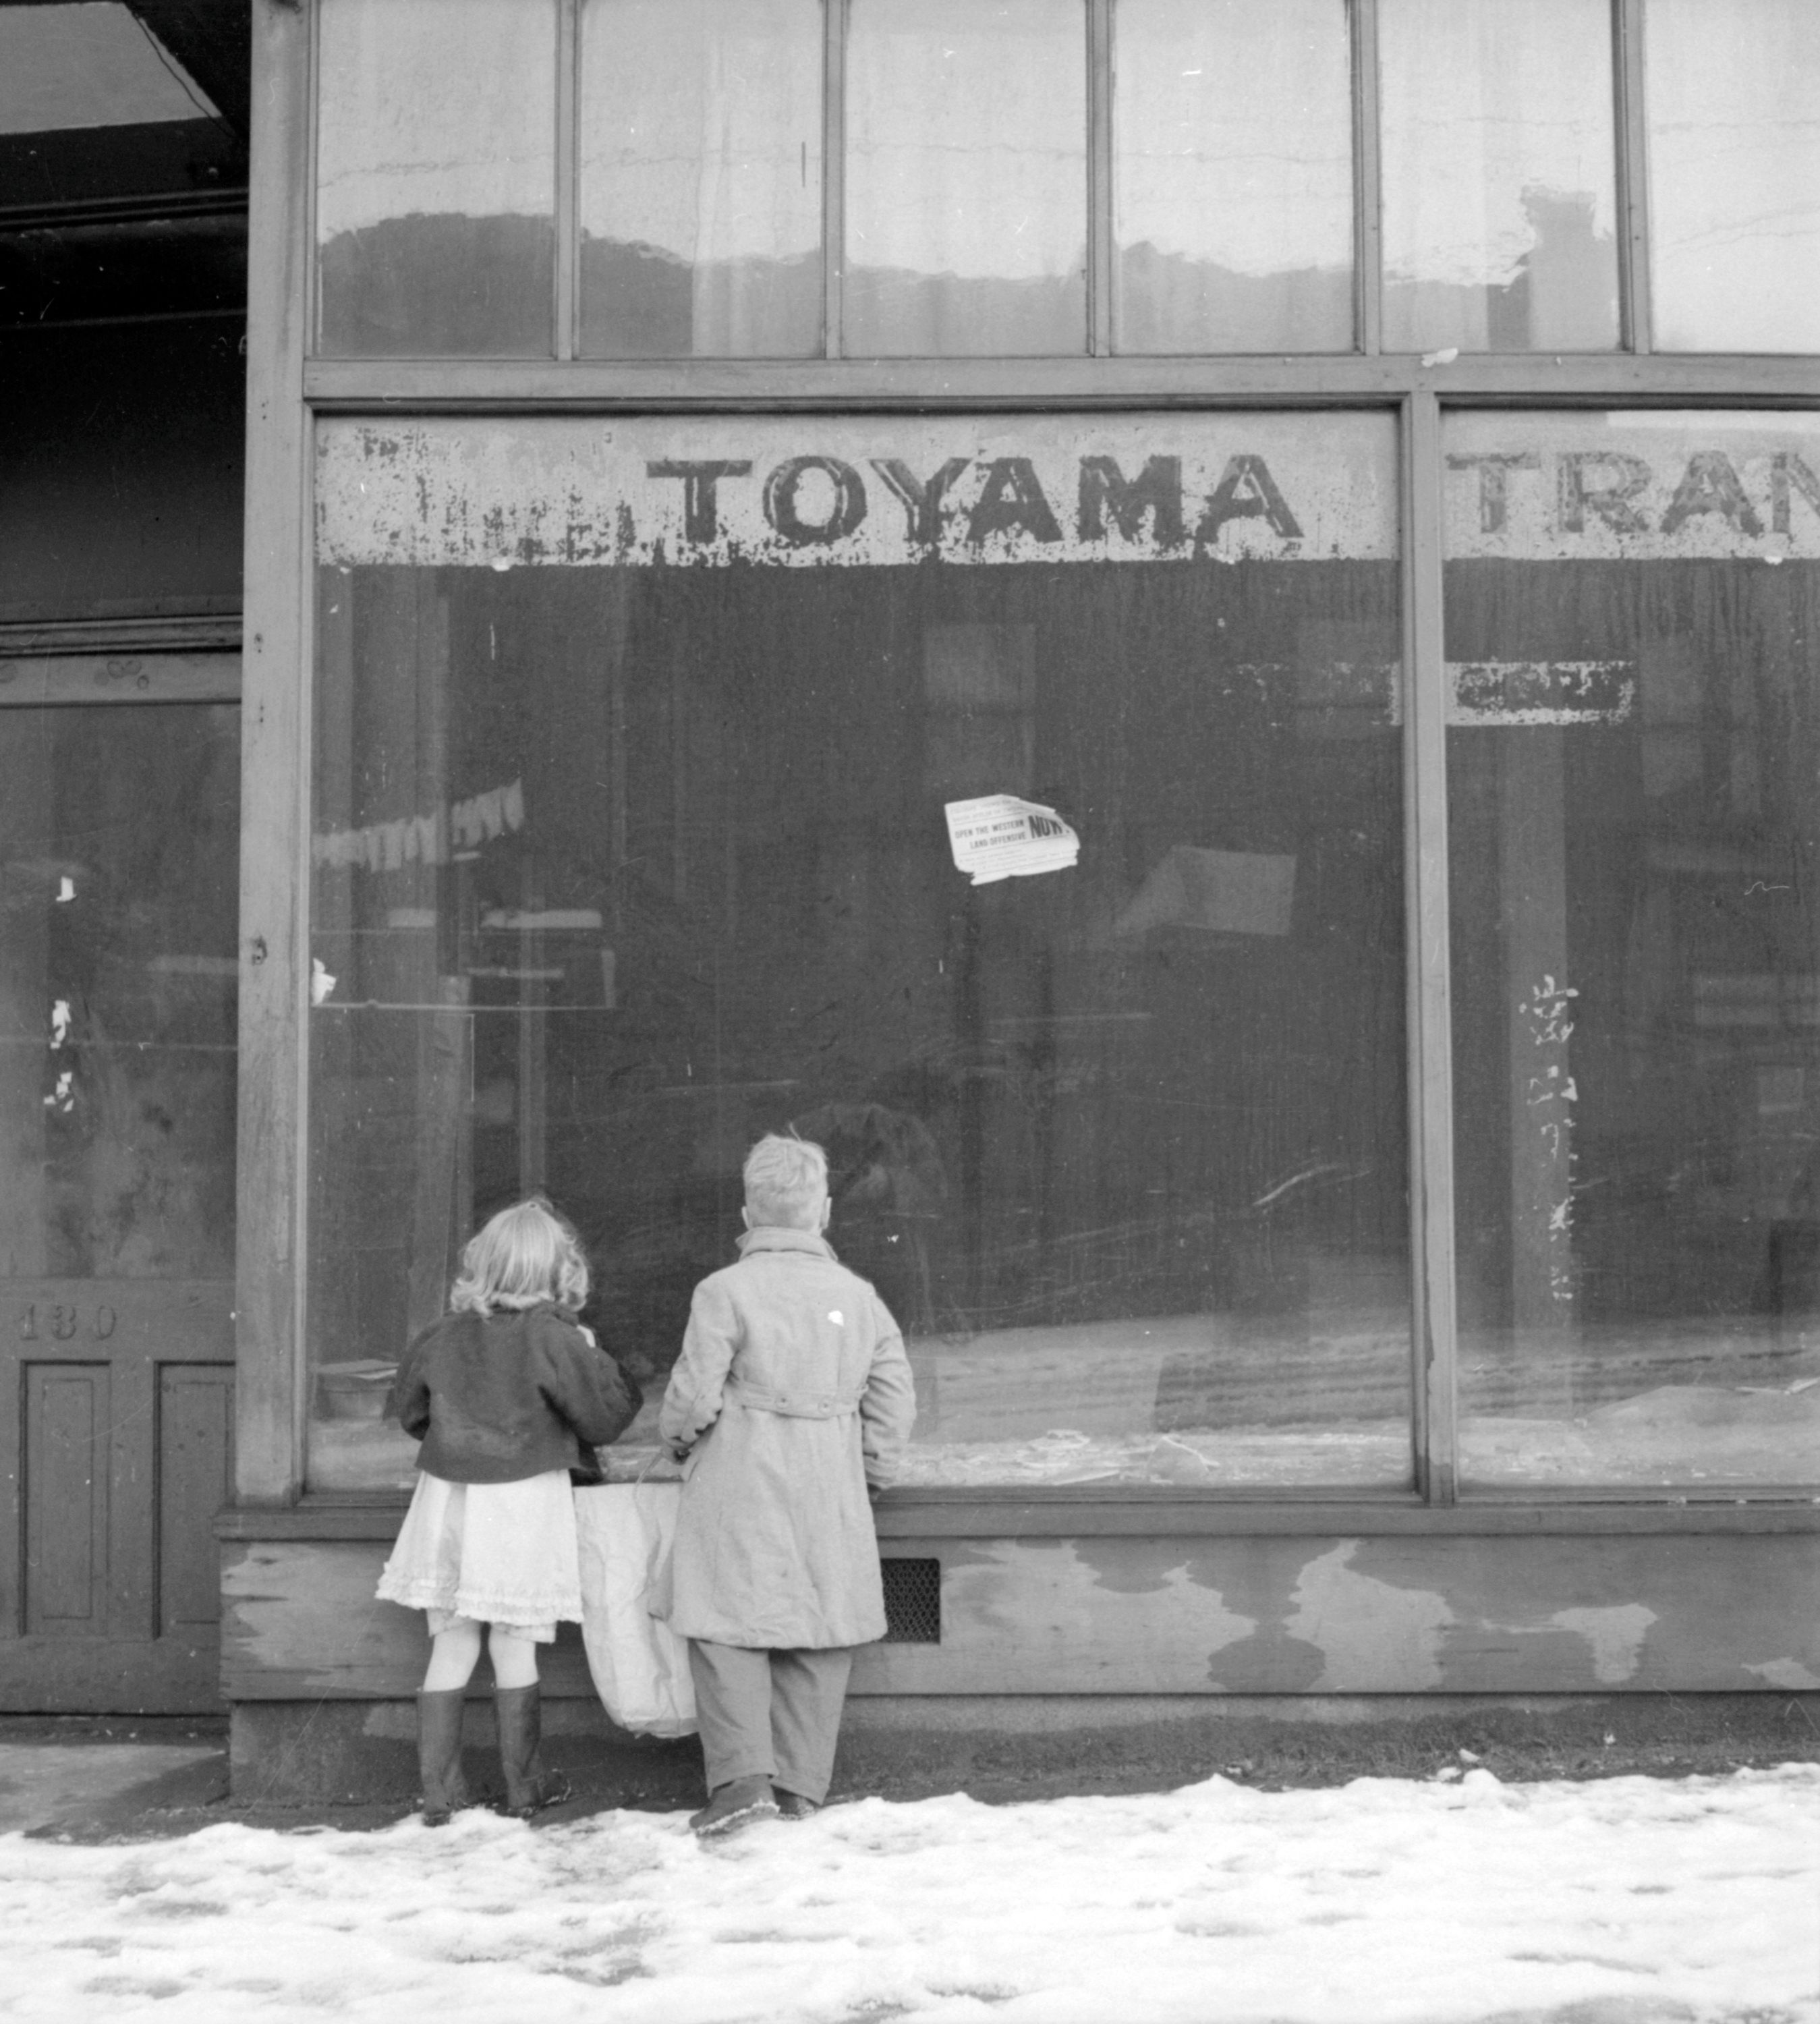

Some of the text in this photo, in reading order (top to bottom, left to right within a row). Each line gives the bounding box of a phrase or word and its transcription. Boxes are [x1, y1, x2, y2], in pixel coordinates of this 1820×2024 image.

[646, 454, 1305, 544] TOYAMA
[955, 819, 1025, 839] OPEN THE WESTERN
[970, 832, 1026, 849] LAND OFFENSIVE
